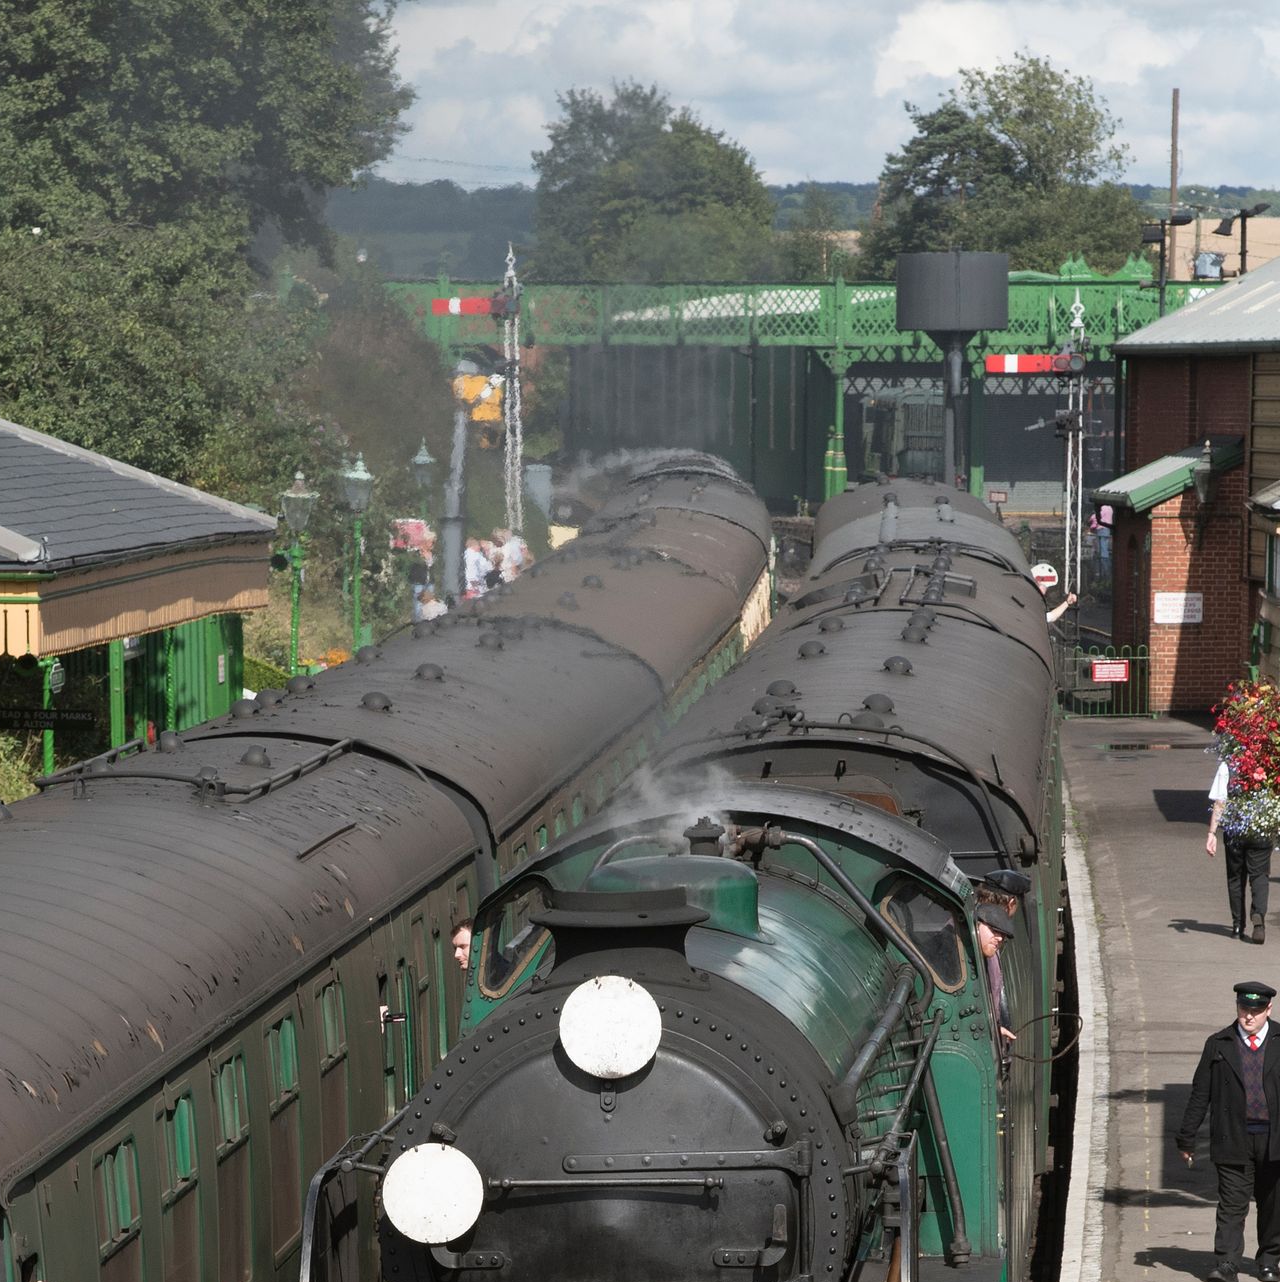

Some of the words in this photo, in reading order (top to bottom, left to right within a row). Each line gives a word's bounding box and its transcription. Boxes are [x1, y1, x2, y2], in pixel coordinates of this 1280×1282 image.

[33, 711, 58, 720] FOUR
[60, 712, 93, 721] MARKS
[23, 720, 55, 728] ALTON
